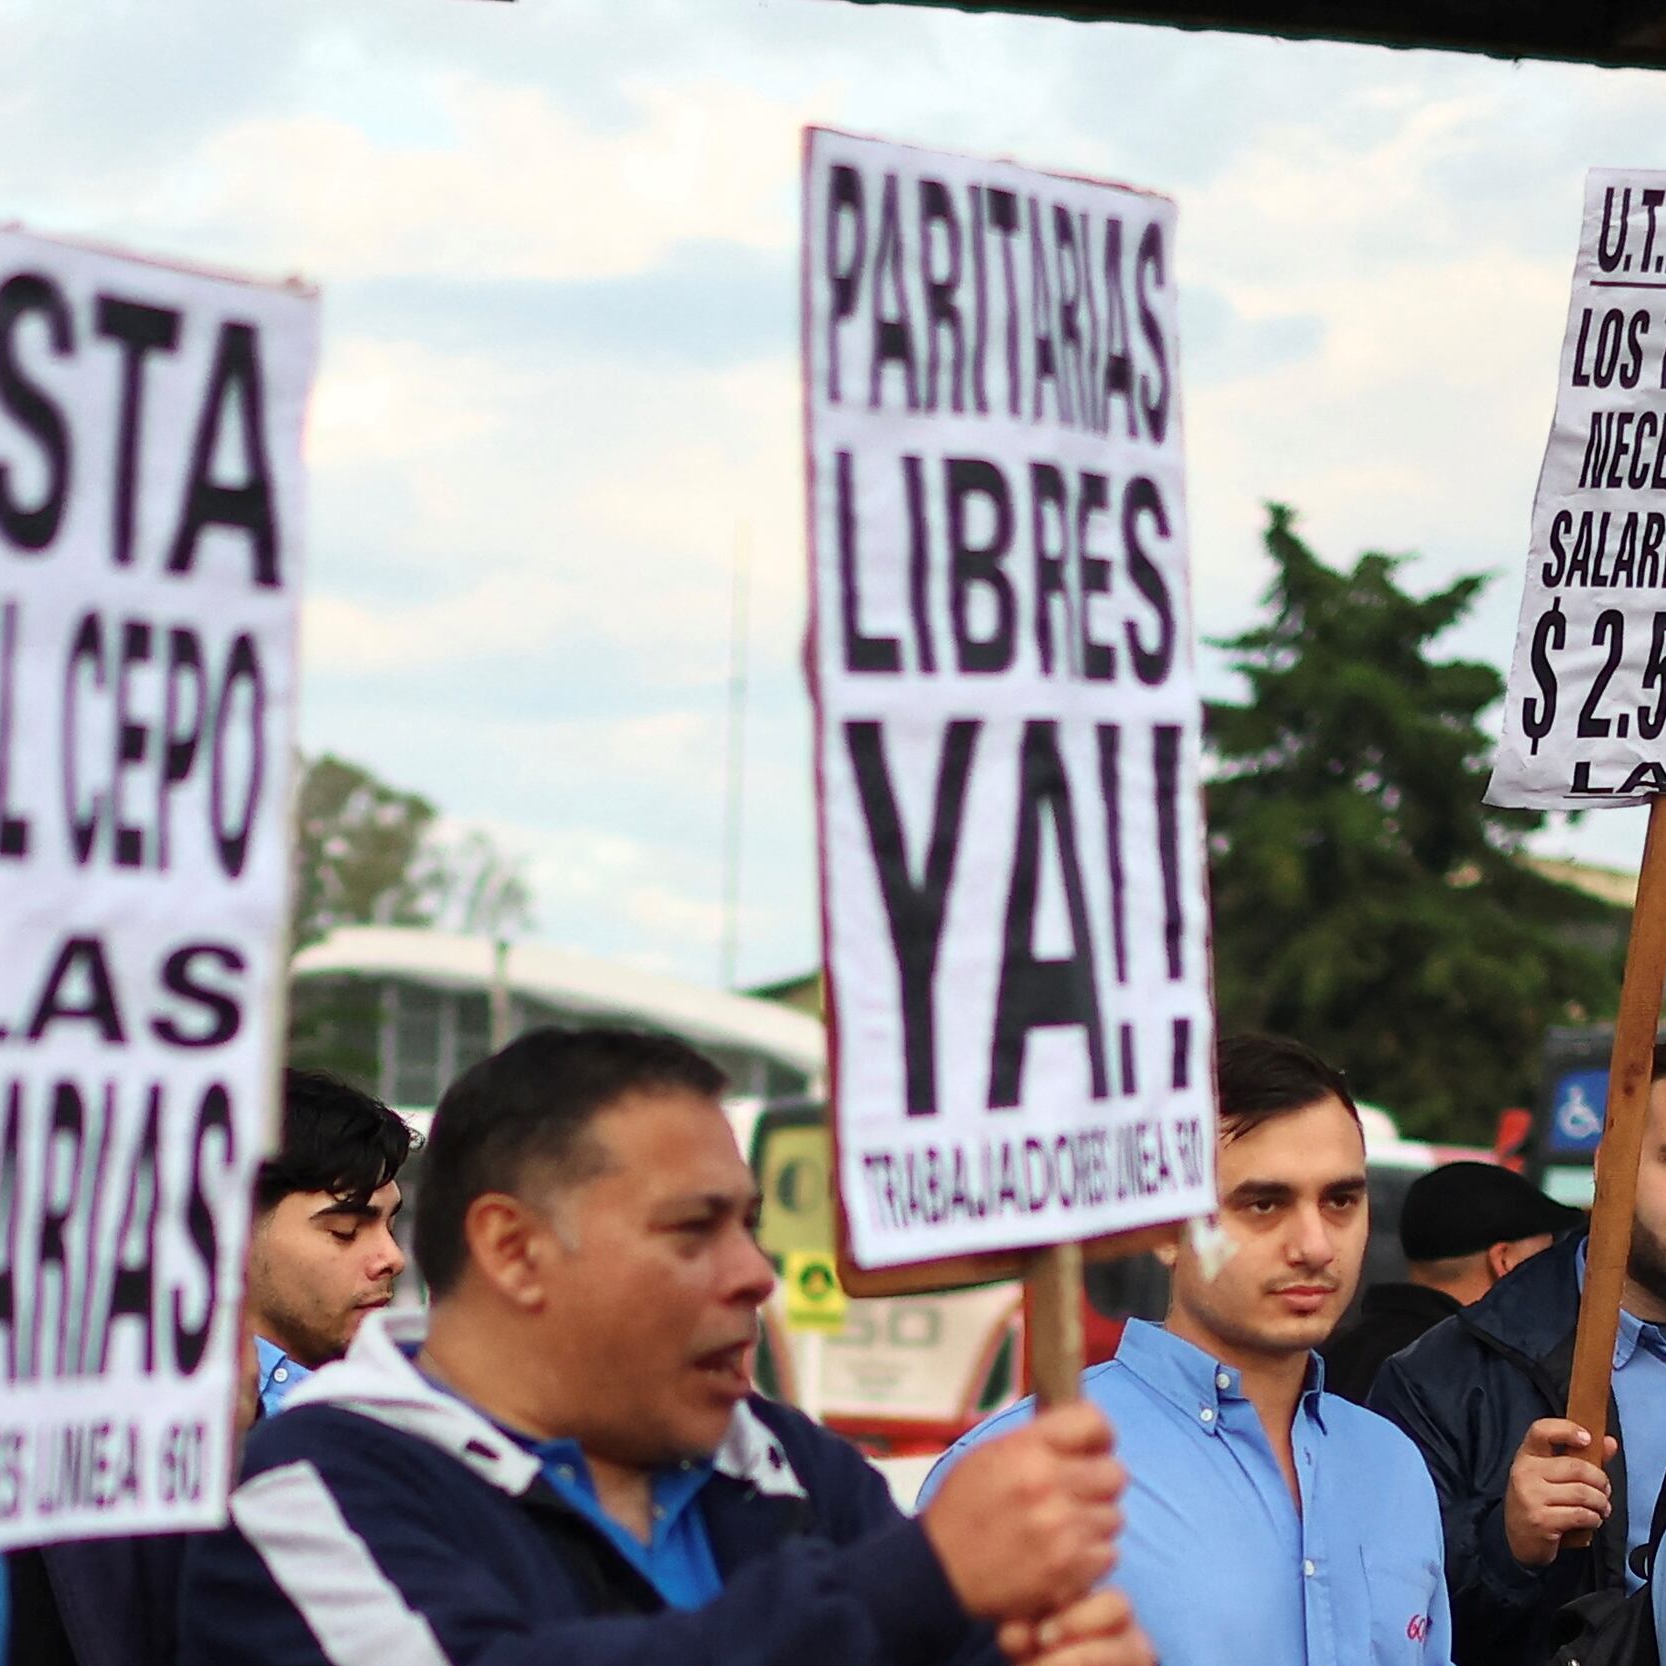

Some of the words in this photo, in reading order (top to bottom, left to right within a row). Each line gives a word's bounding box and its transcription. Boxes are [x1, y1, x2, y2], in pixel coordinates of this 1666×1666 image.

[826, 165, 1171, 445] PARITARIAS
[1571, 307, 1650, 389] LOS
[834, 451, 1176, 687] LIBRES
[63, 608, 265, 880] CEPO
[843, 719, 1191, 1117] YA!!
[863, 1131, 1107, 1229] TRABAJADORES
[37, 1421, 140, 1515] LINEA
[163, 1421, 205, 1504] 60
